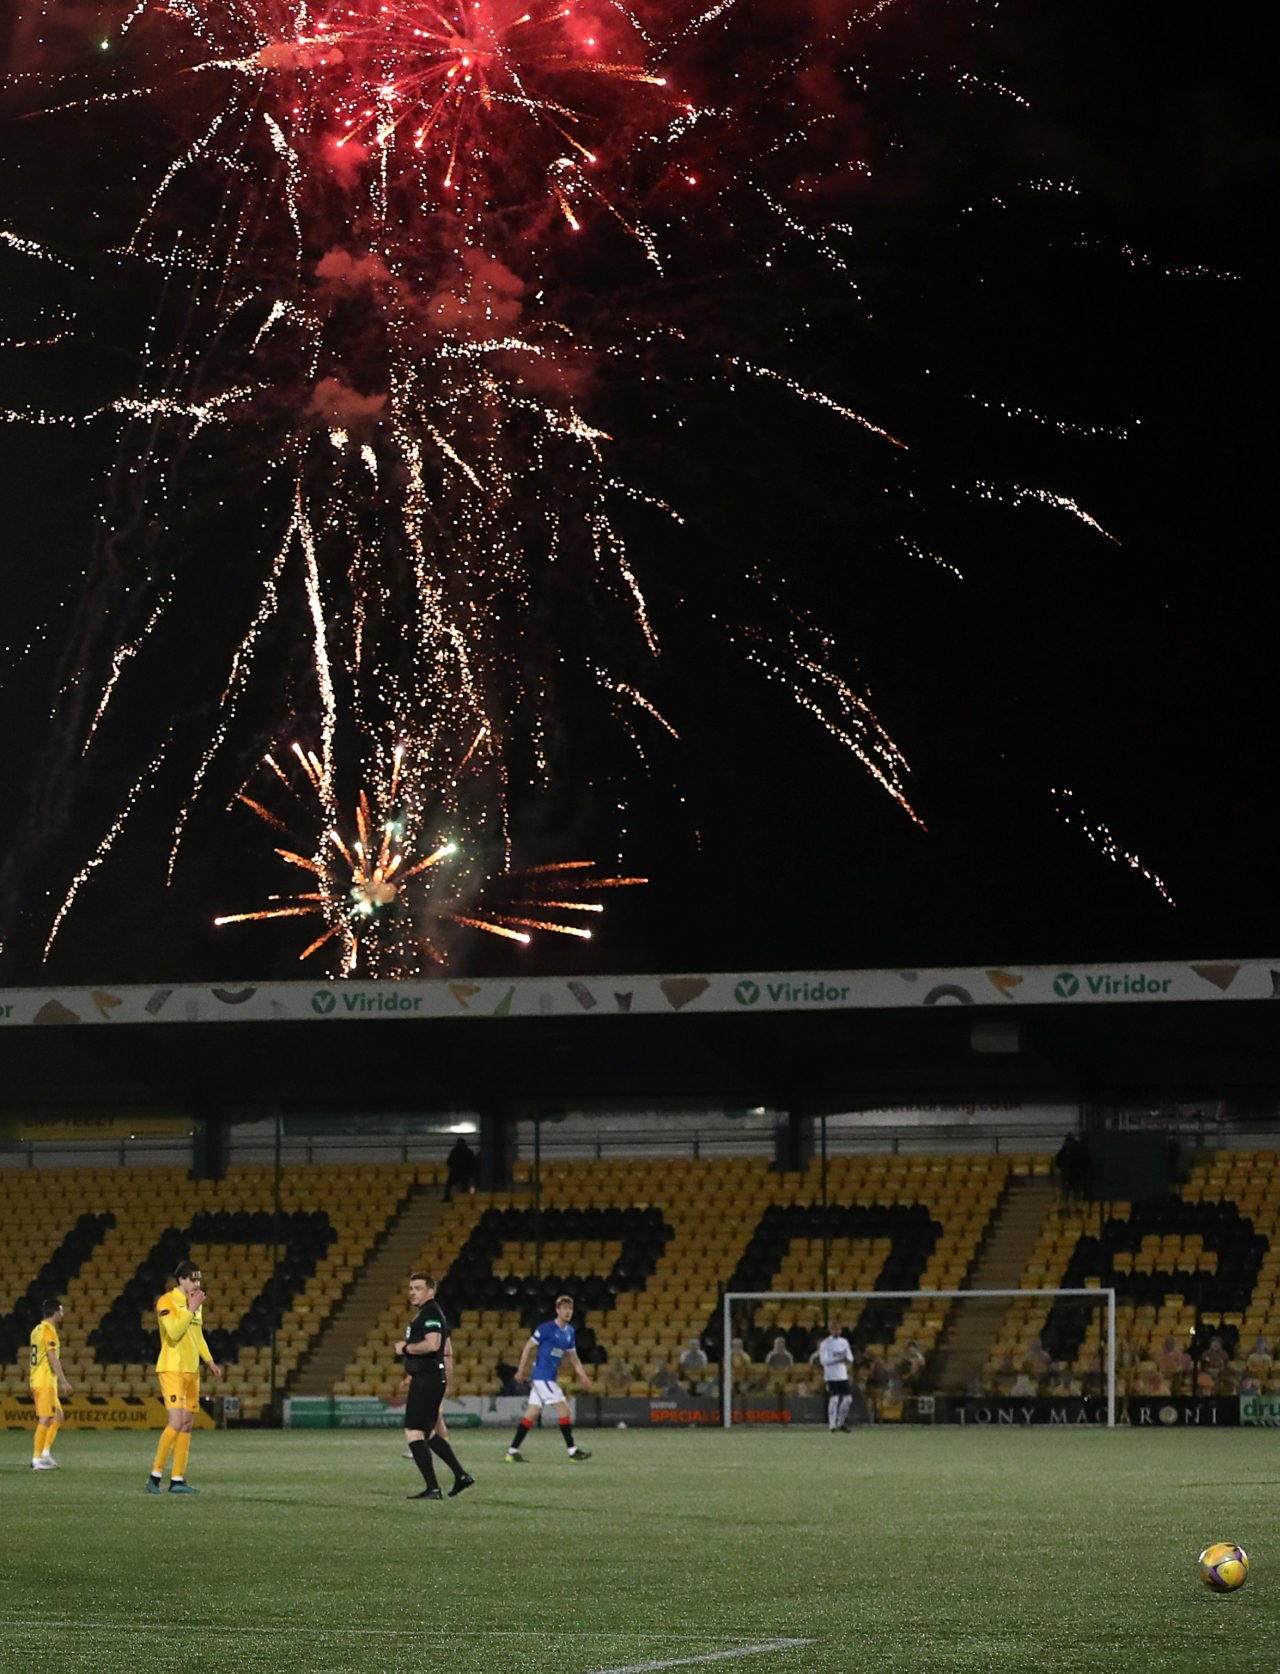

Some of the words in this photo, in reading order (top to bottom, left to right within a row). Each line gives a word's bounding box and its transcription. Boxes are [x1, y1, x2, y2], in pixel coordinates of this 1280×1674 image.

[766, 981, 851, 1003] Viridor
[1086, 974, 1173, 996] Viridor
[342, 991, 423, 1013] Viridor
[746, 1409, 791, 1423] SIGNS
[955, 1406, 1036, 1425] TONY
